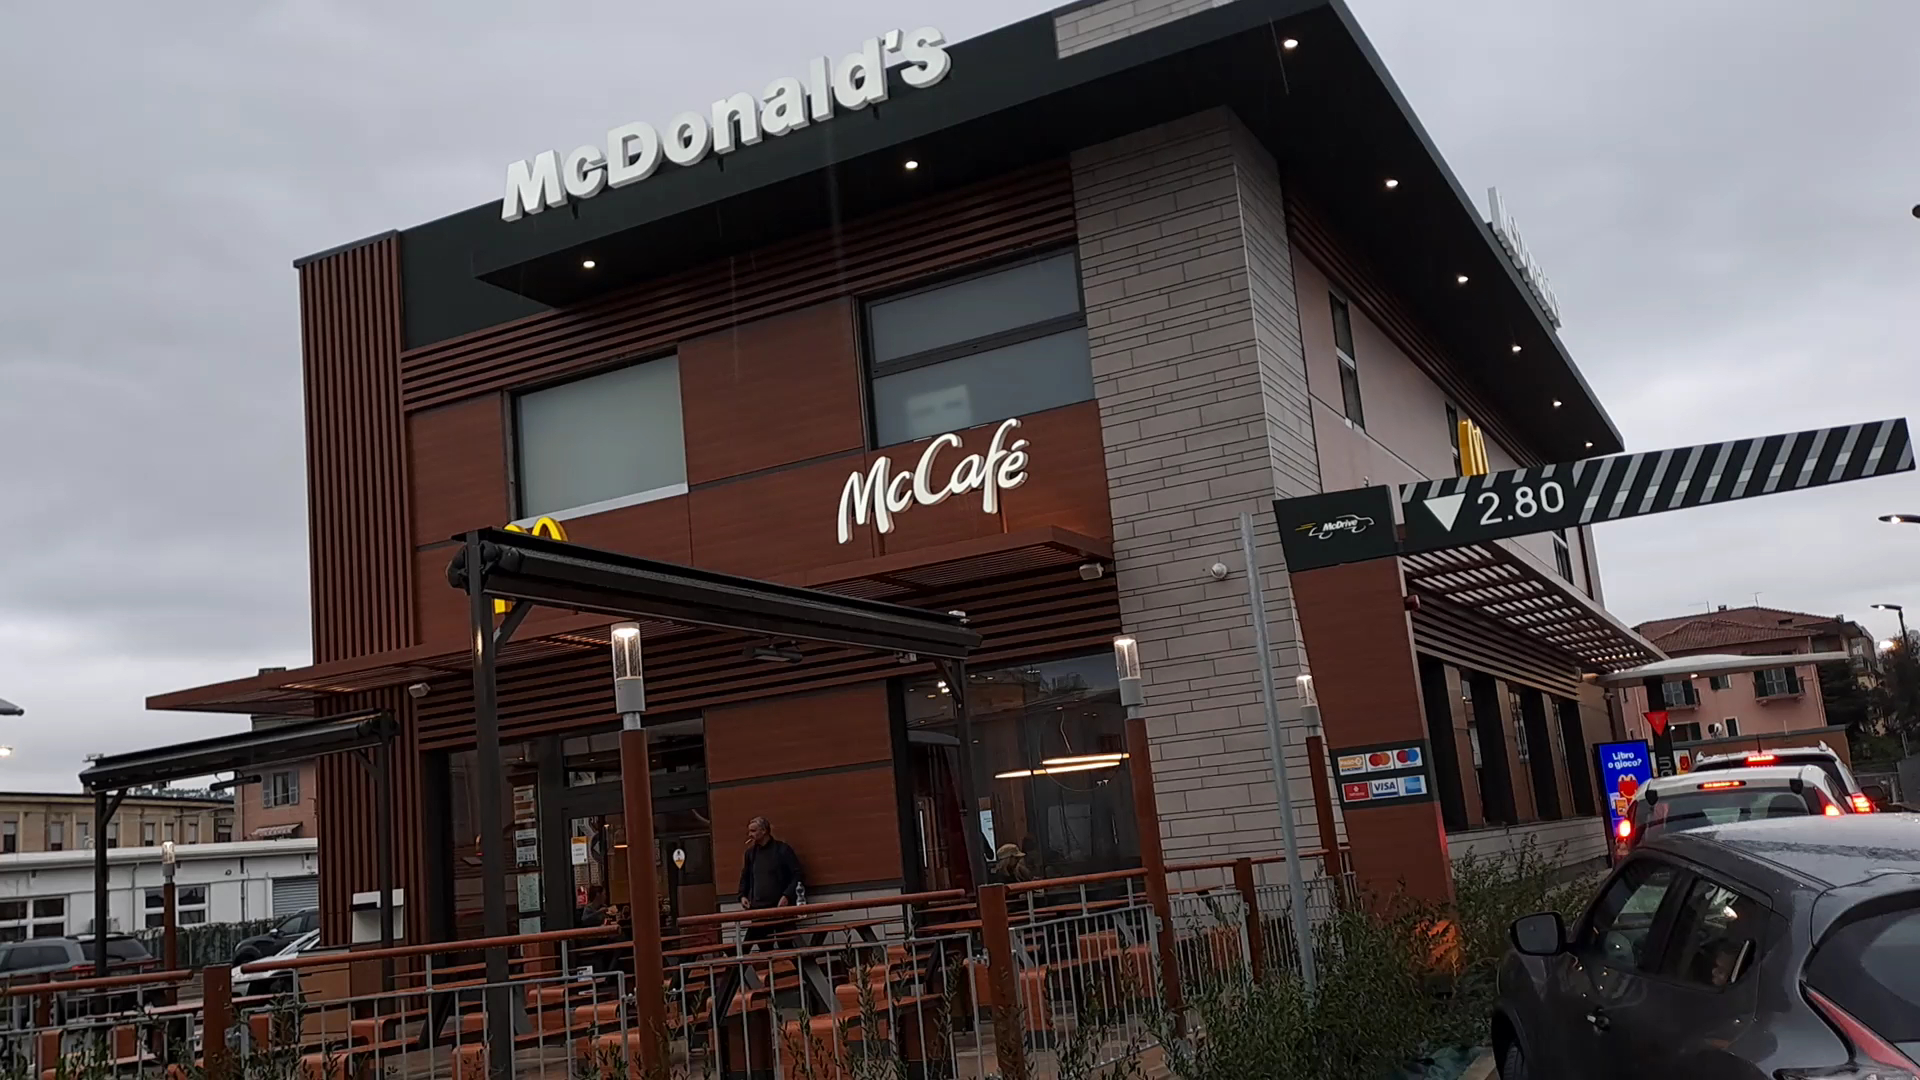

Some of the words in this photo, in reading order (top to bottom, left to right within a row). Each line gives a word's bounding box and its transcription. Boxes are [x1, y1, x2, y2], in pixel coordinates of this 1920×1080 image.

[501, 26, 952, 222] McDonald's
[838, 418, 1030, 544] McCafé
[1477, 481, 1565, 525] 2.80
[1322, 519, 1358, 532] McDrive
[1612, 752, 1634, 760] Libro
[1614, 759, 1642, 770] gioco?
[1374, 781, 1396, 791] VISA
